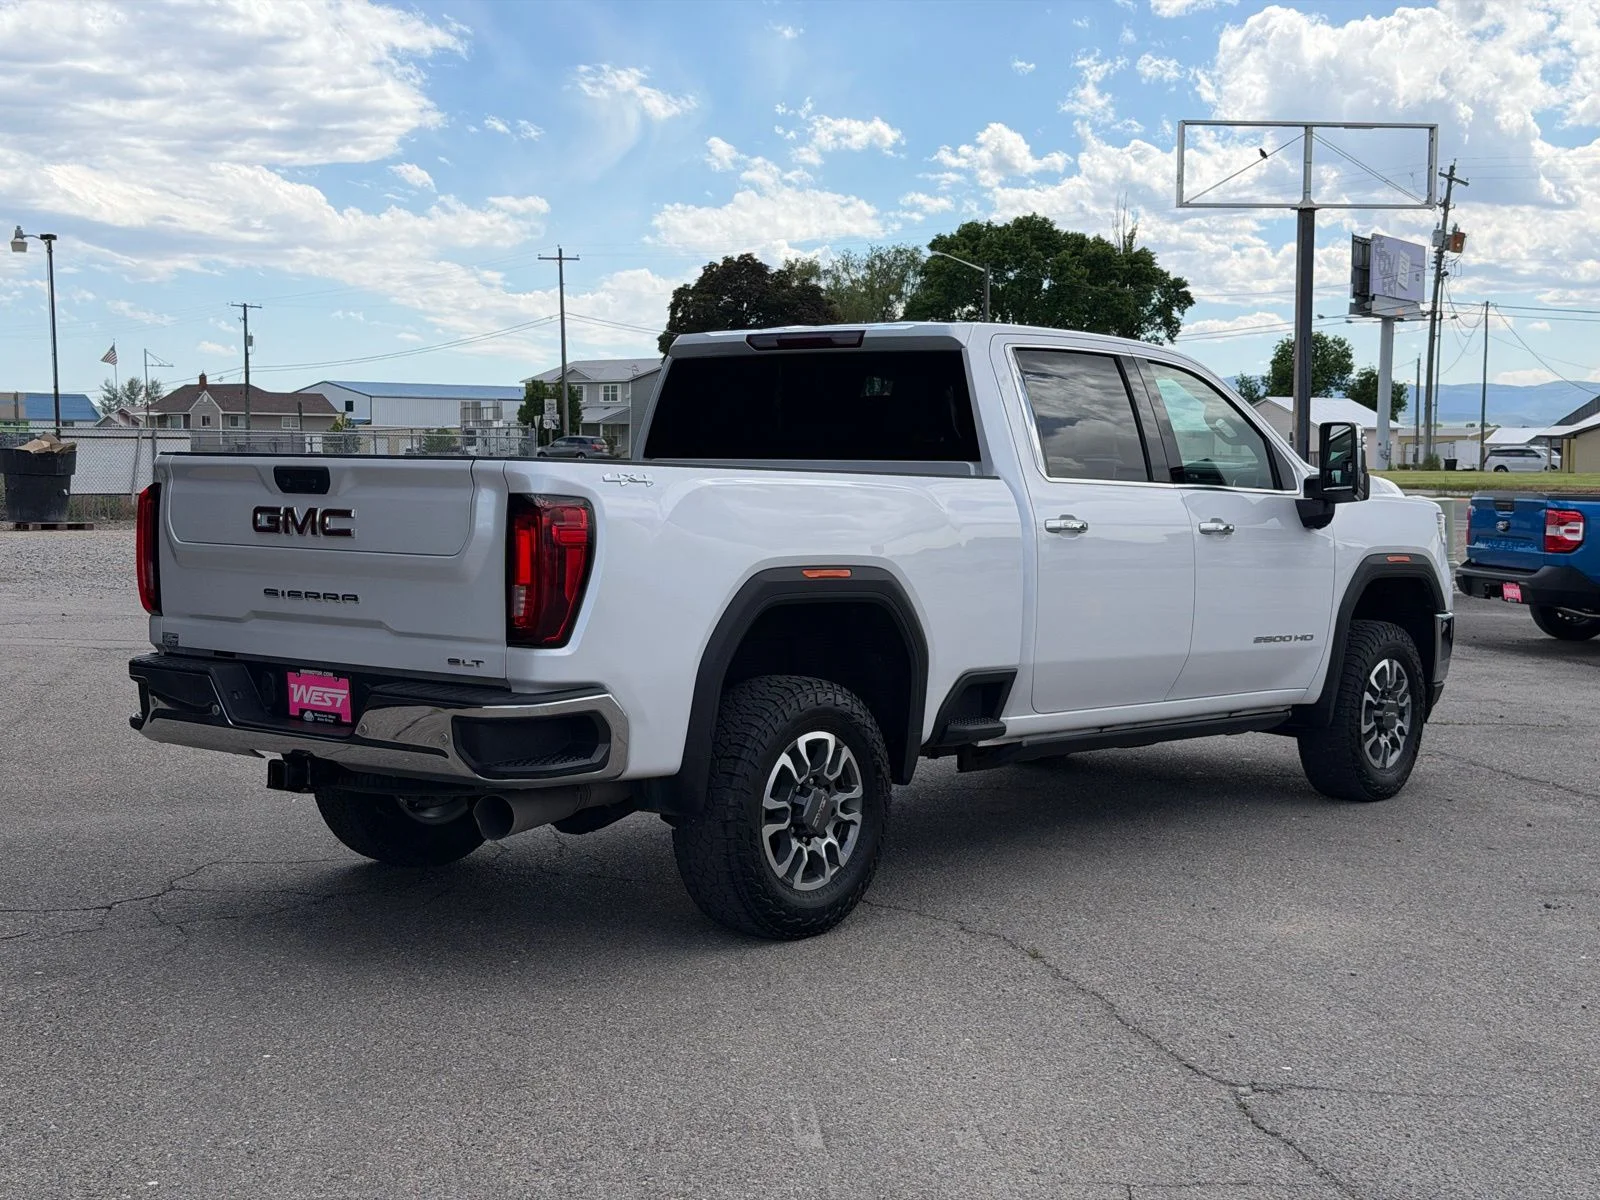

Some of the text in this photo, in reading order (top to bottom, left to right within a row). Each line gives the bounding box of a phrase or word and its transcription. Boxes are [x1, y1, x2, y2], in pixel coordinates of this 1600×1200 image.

[252, 505, 356, 537] GMC
[263, 588, 360, 603] SIERRA
[1253, 634, 1314, 644] 2500 HD
[447, 657, 485, 668] SLT
[290, 683, 349, 708] WEST
